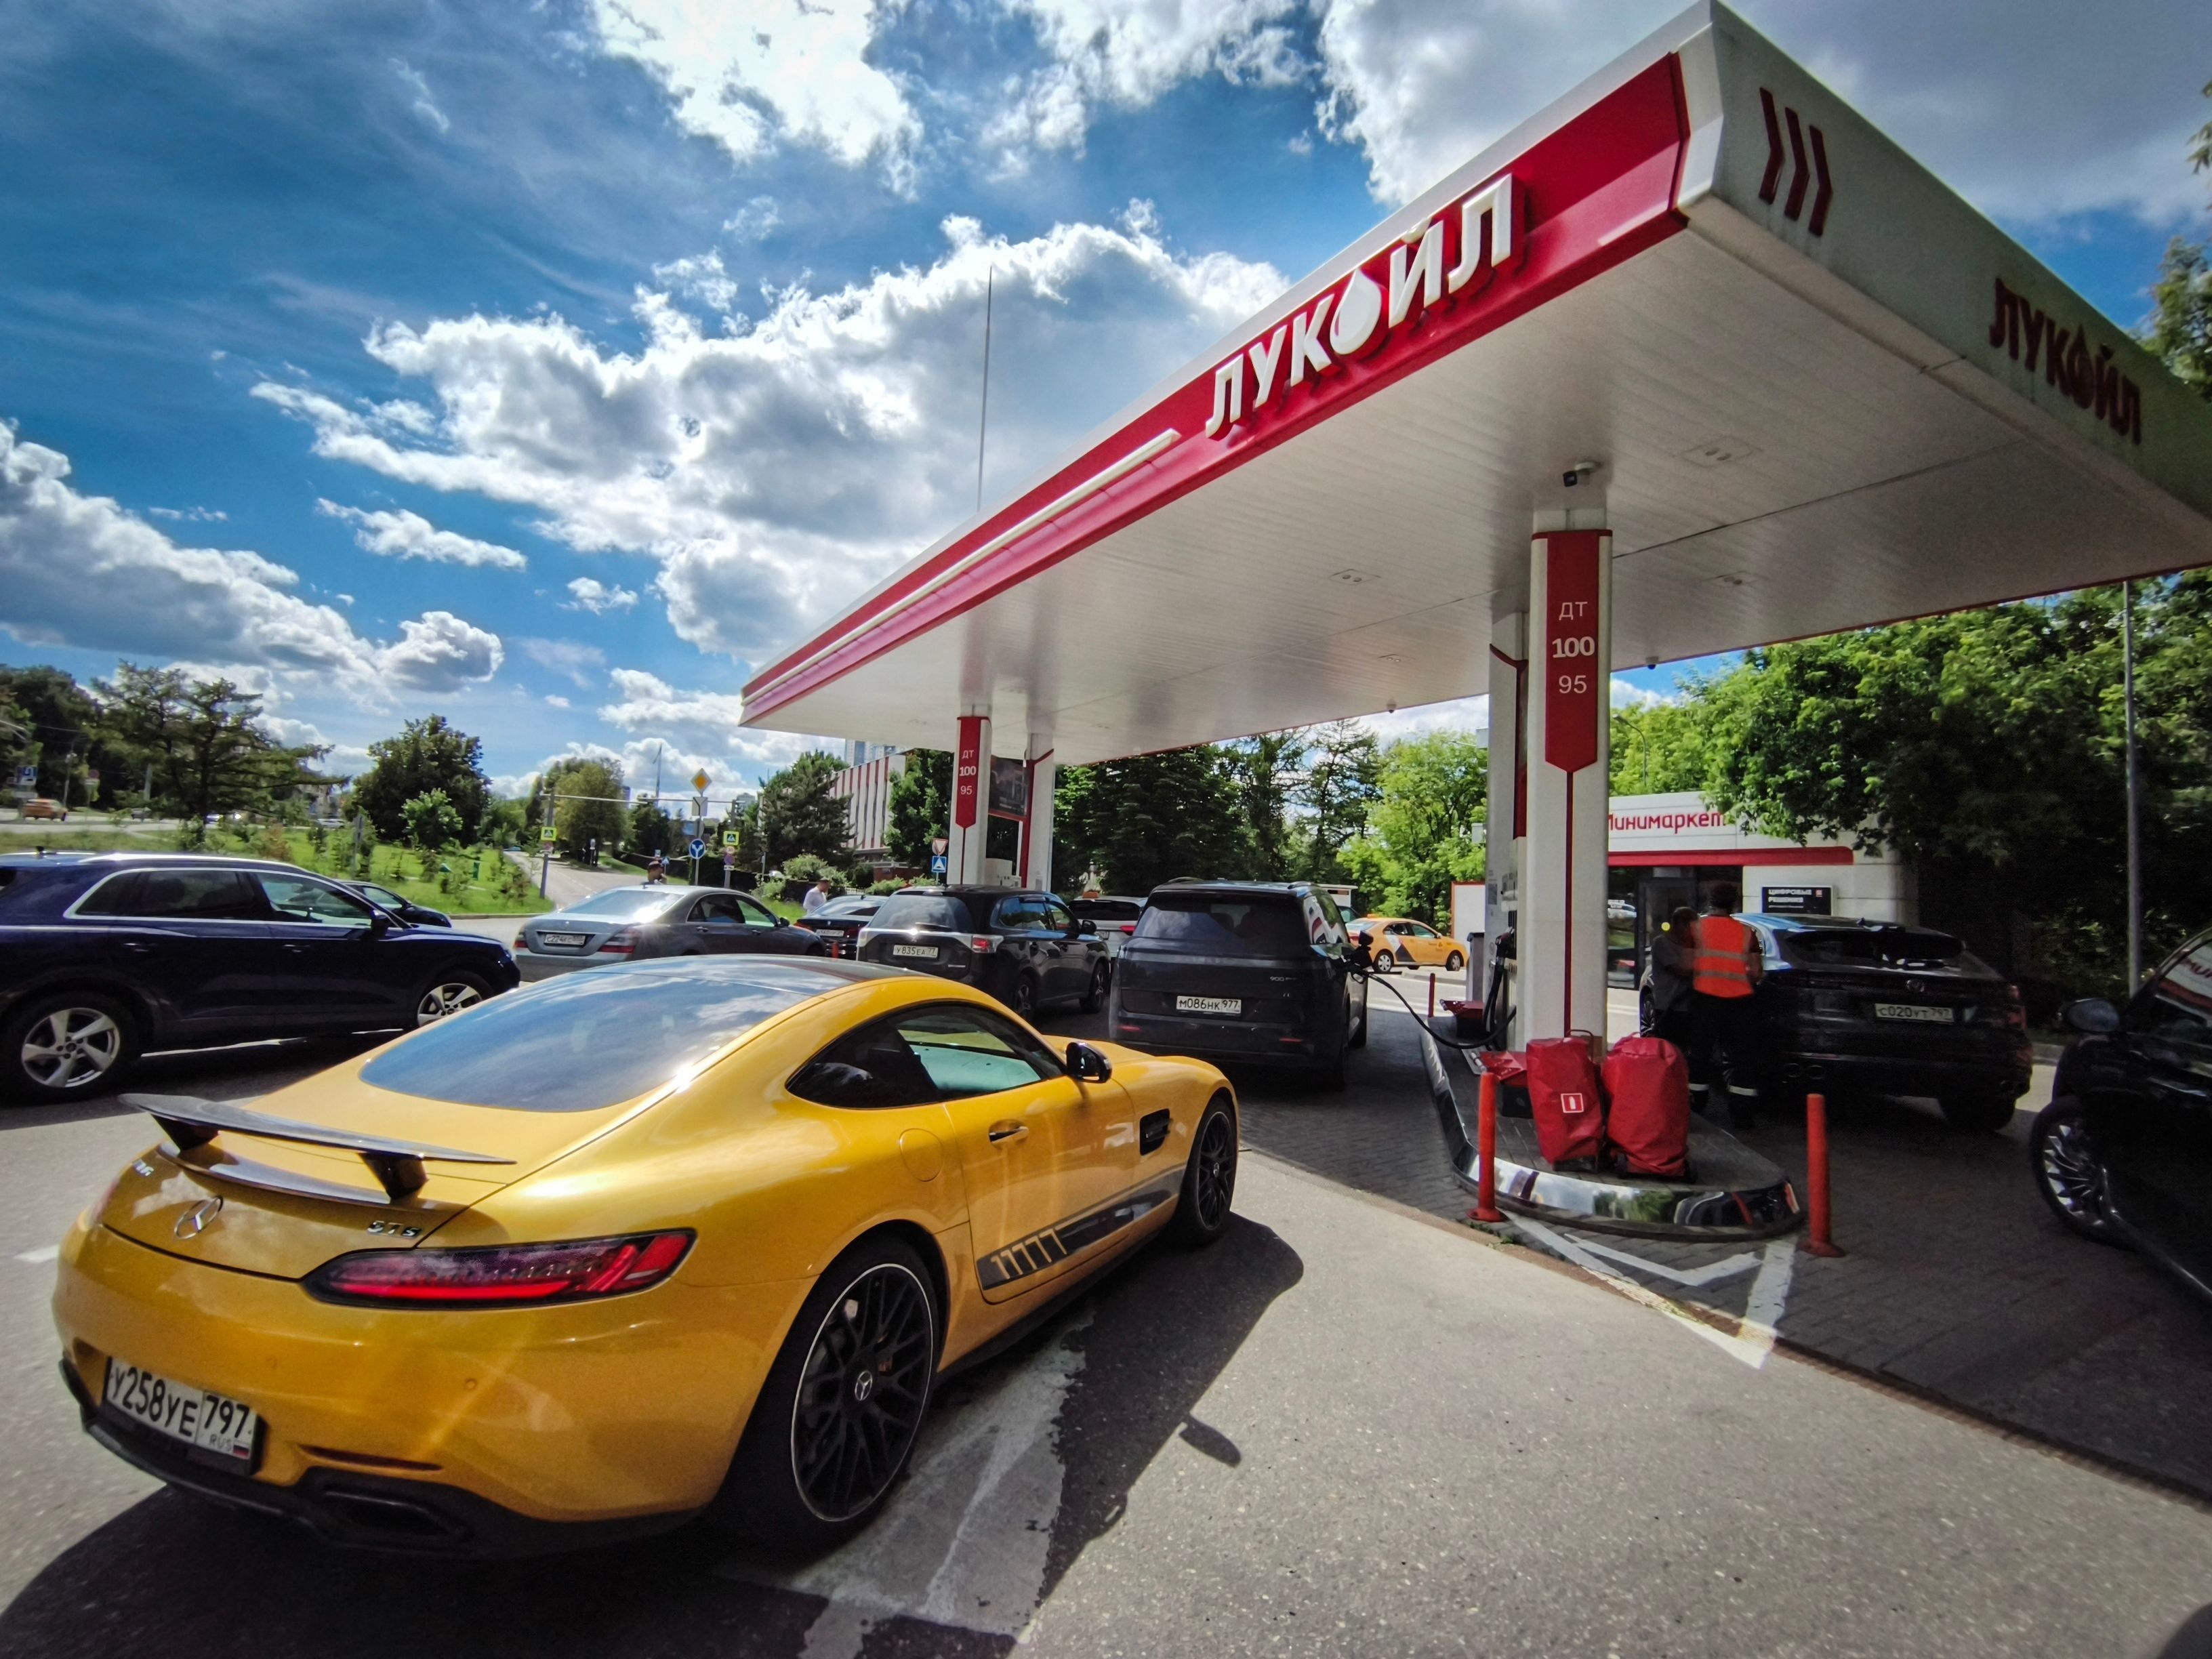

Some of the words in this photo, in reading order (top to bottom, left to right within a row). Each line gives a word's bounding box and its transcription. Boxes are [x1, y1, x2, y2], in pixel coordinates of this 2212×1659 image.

[1205, 173, 1512, 438] ЛУКОЙЛ
[1989, 278, 2142, 445] ЛУКОЙЛ
[1559, 601, 1588, 620] ДТ
[1552, 636, 1595, 658] 100
[1559, 675, 1587, 694] 95
[962, 749, 975, 759] ДТ
[959, 766, 977, 777] 100
[960, 785, 972, 796] 95
[209, 1433, 232, 1451] RUS
